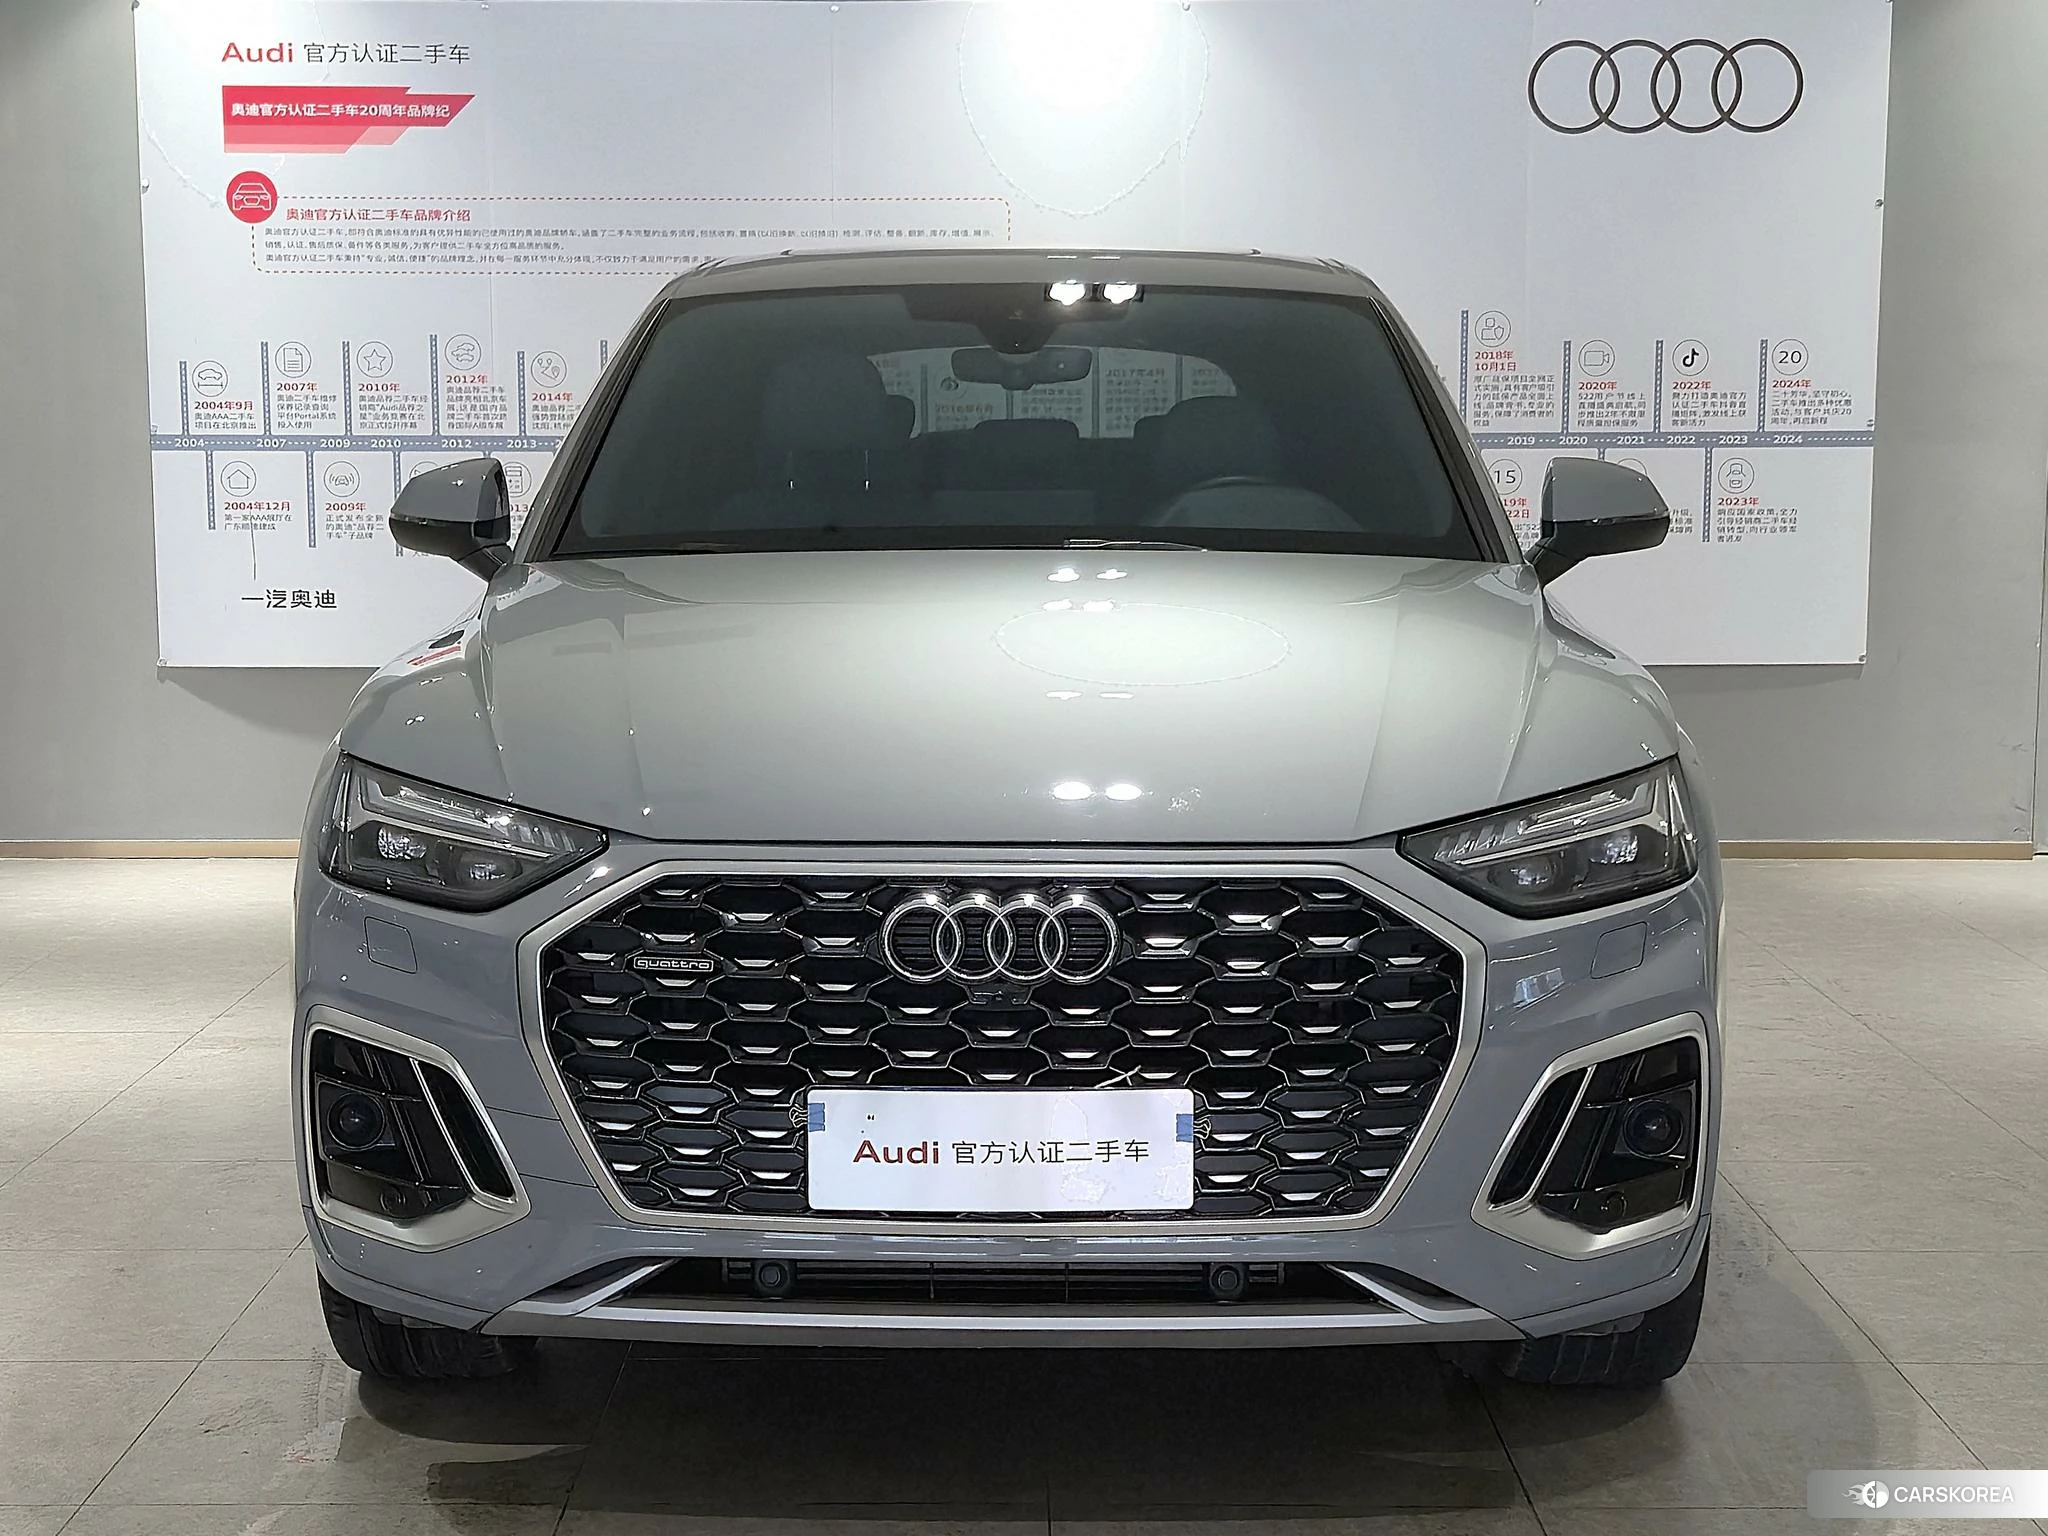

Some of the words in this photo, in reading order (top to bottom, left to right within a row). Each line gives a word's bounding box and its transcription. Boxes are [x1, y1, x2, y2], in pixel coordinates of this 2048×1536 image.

[221, 42, 293, 63] Audi
[303, 43, 471, 64] 官方认证二手车
[286, 207, 471, 223] 奥迪官方认证二手车品牌介绍
[1475, 351, 1513, 360] 2018年
[1778, 350, 1802, 364] 20
[1475, 362, 1516, 371] 10月1日
[446, 375, 488, 384] 2012年
[1772, 379, 1811, 388] 2024年
[276, 383, 318, 392] 2007年
[358, 383, 400, 392] 2010年
[1578, 381, 1617, 390] 2020年
[1672, 381, 1711, 390] 2022年
[532, 392, 573, 401] 2014年
[194, 401, 253, 410] 2004年9月
[174, 439, 205, 448] 2004
[256, 439, 286, 448] 2007
[320, 439, 350, 448] 2009
[371, 439, 401, 448] 2010
[441, 439, 472, 449] 2012
[506, 439, 537, 449] 2013
[1507, 436, 1535, 445] 2019
[1559, 436, 1587, 445] 2020
[1617, 436, 1645, 445] 2021
[1666, 435, 1696, 445] 2022
[1718, 435, 1748, 445] 2023
[1773, 435, 1803, 444] 2024
[1494, 469, 1516, 484] 15
[224, 501, 290, 511] 2004年12月
[1717, 497, 1759, 506] 2023年
[325, 502, 367, 511] 2009年
[241, 589, 338, 609] 一汽奥迪
[637, 959, 710, 970] quattro
[852, 1139, 939, 1165] Audi
[952, 1140, 1150, 1164] 官方认证二手车
